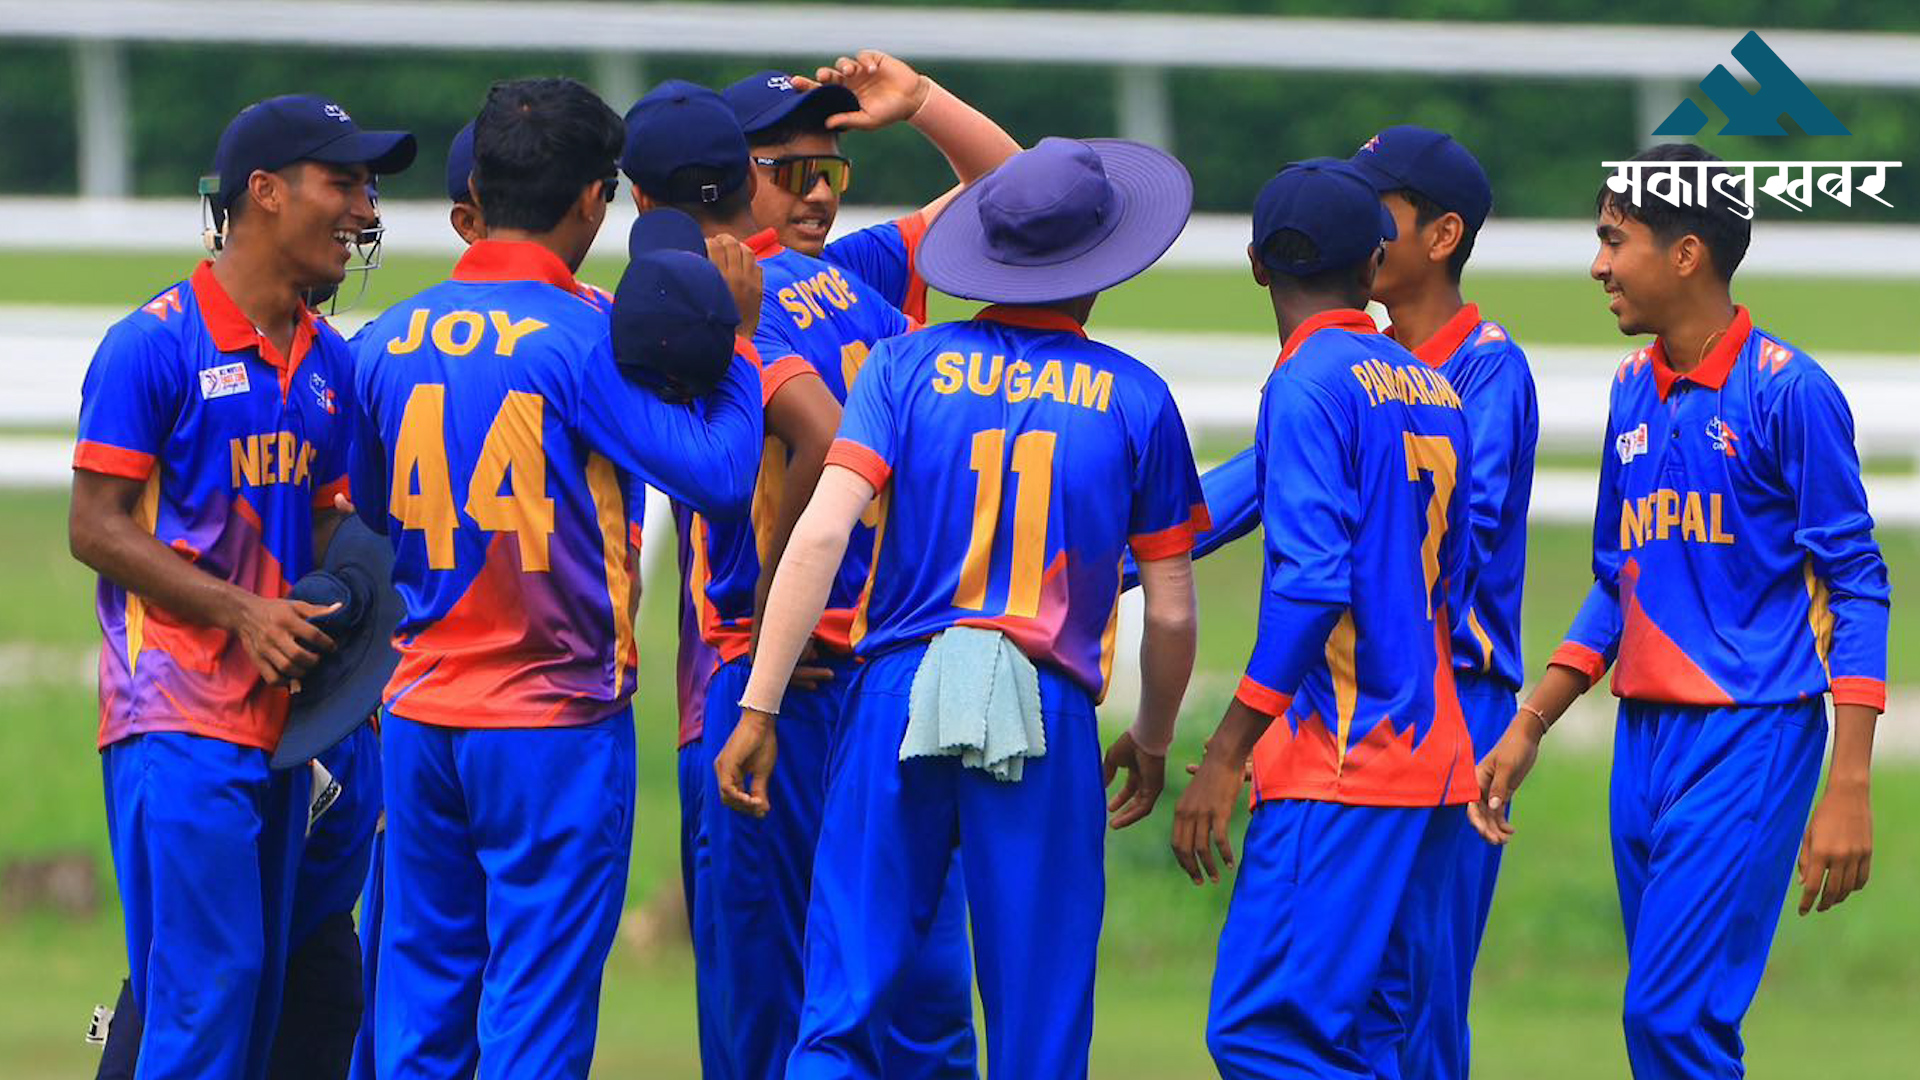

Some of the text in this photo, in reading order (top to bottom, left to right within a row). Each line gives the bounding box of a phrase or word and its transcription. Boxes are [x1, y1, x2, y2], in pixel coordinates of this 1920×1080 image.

[387, 309, 547, 356] JOY
[933, 352, 1114, 412] SUGAM
[231, 431, 316, 483] NEPA
[389, 384, 556, 572] 44
[953, 429, 1057, 617] 11
[1402, 431, 1457, 620] 7
[1619, 488, 1736, 552] NEPAL
